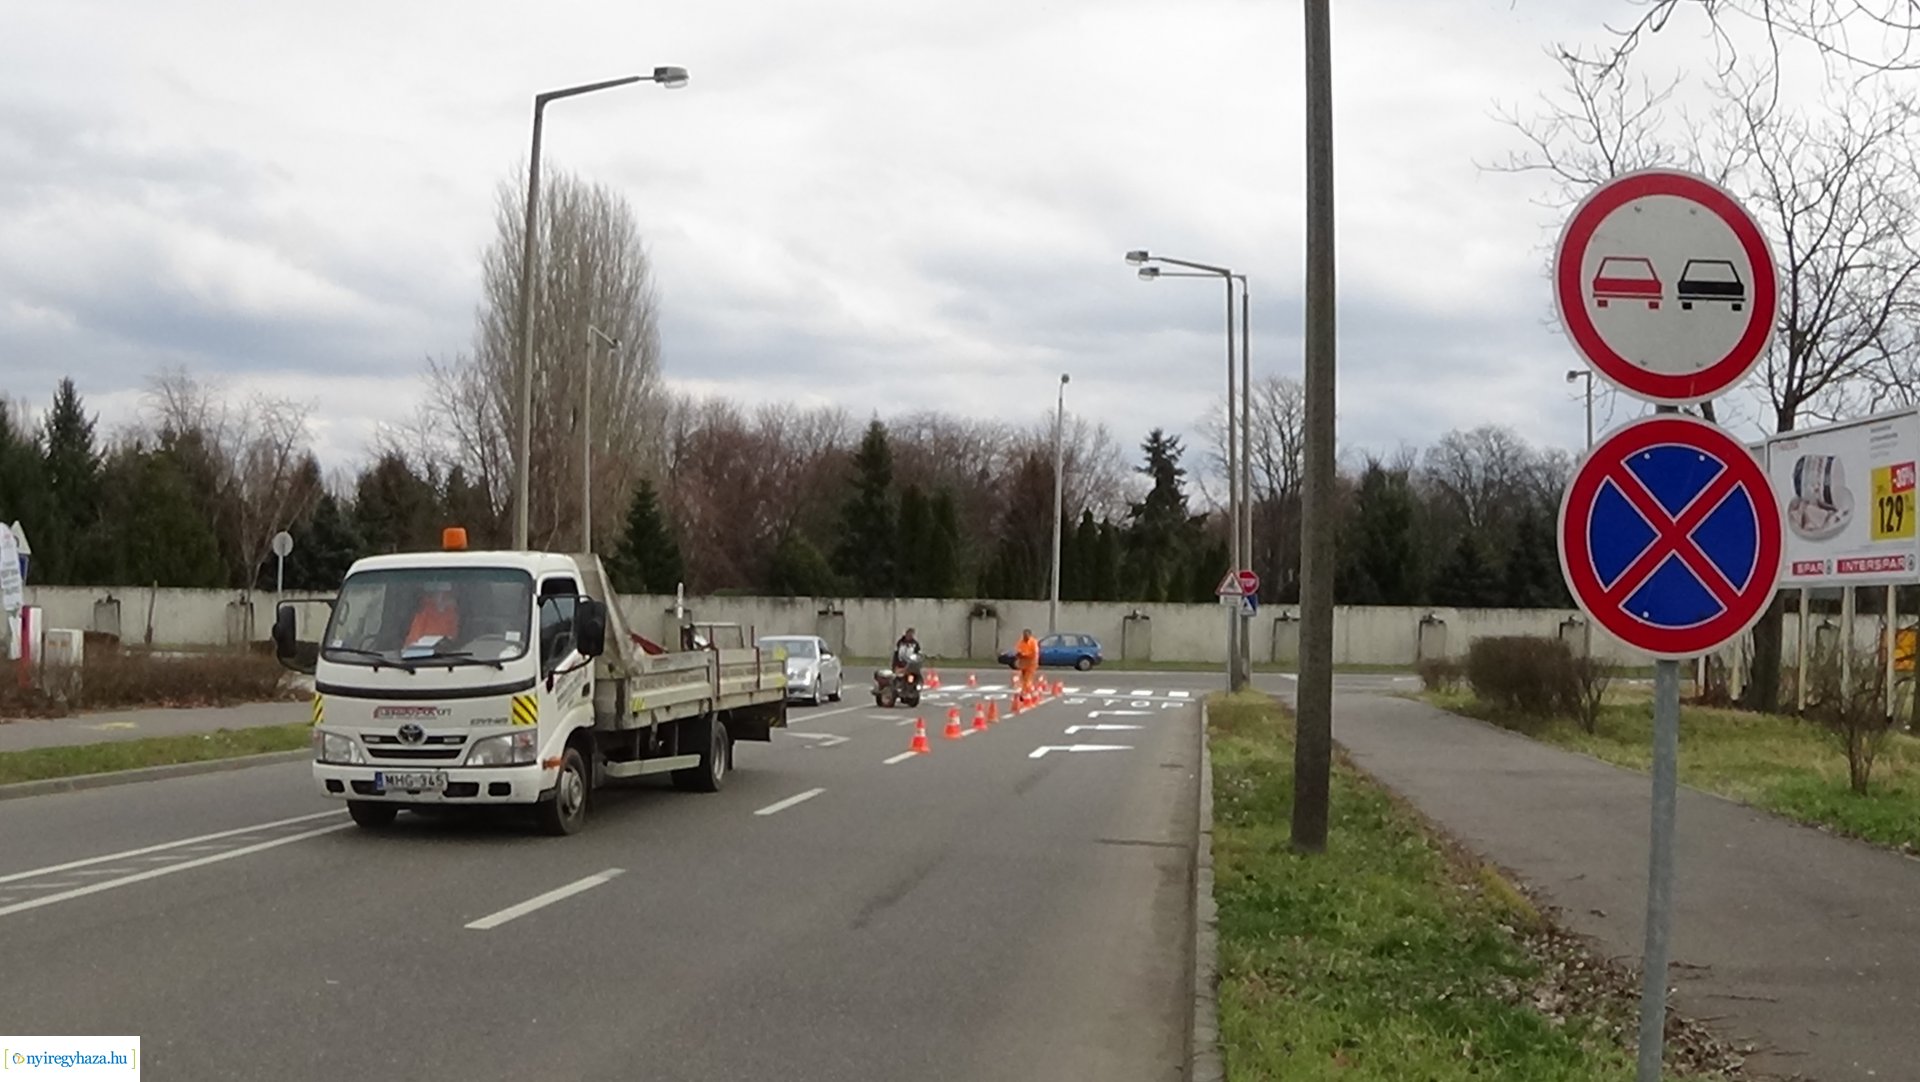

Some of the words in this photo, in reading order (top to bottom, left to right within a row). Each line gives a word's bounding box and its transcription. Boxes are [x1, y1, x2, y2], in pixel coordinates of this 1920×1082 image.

[1878, 495, 1904, 533] 129
[1797, 562, 1824, 576] SPAR
[1841, 557, 1905, 572] INTERSPAR
